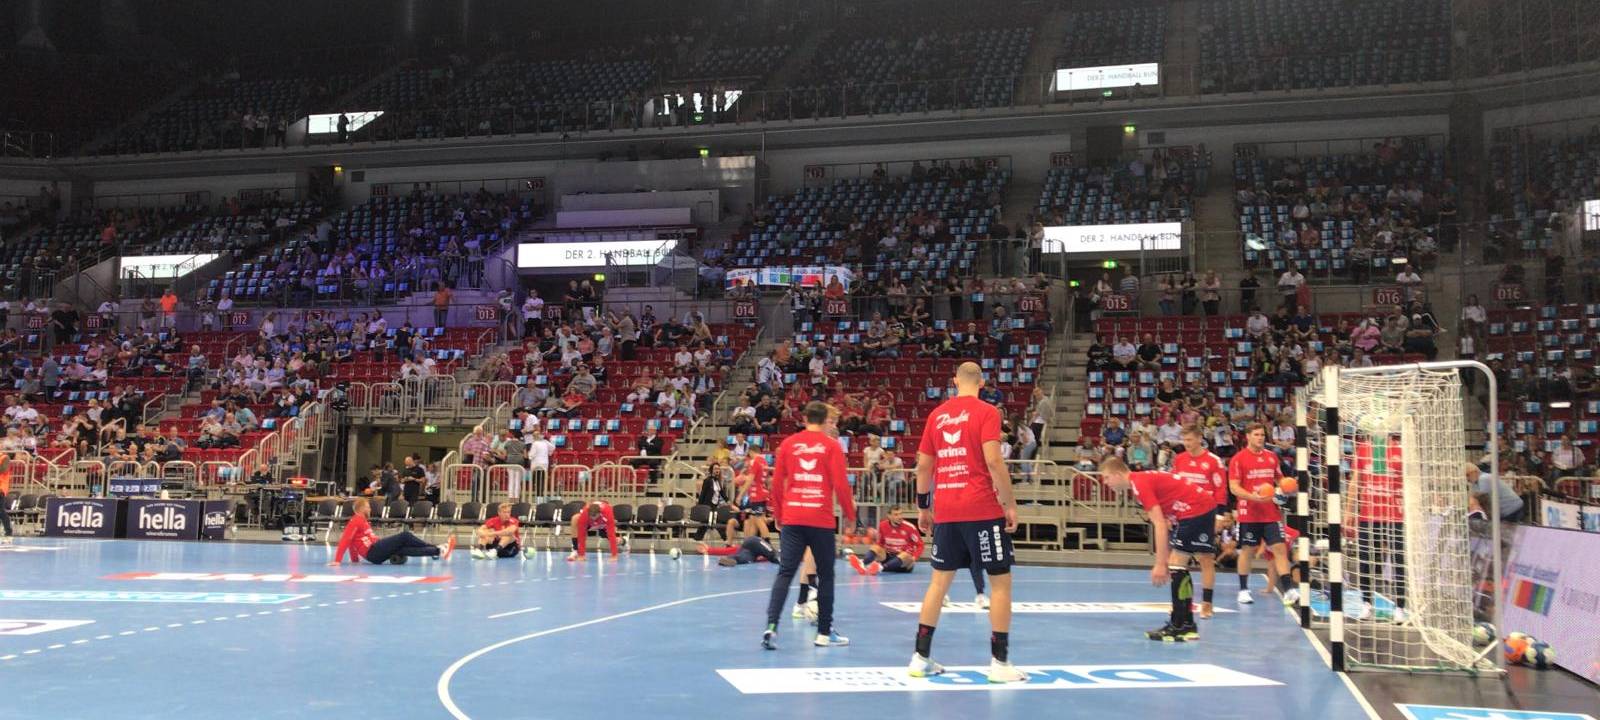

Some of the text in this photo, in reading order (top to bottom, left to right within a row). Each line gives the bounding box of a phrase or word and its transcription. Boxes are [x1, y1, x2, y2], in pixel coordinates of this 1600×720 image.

[1080, 234, 1096, 243] DER
[565, 249, 583, 260] DER
[599, 246, 652, 259] HANDBALL
[1106, 298, 1128, 310] 015
[1377, 292, 1400, 304] 016
[479, 309, 496, 320] 013
[736, 305, 754, 316] 014
[827, 303, 847, 314] 014
[232, 314, 248, 325] 012
[938, 446, 967, 458] erima
[57, 505, 104, 528] hella
[139, 506, 186, 530] hella
[204, 513, 225, 526] hella
[978, 530, 992, 563] FLENS
[928, 669, 1192, 686] DKB
